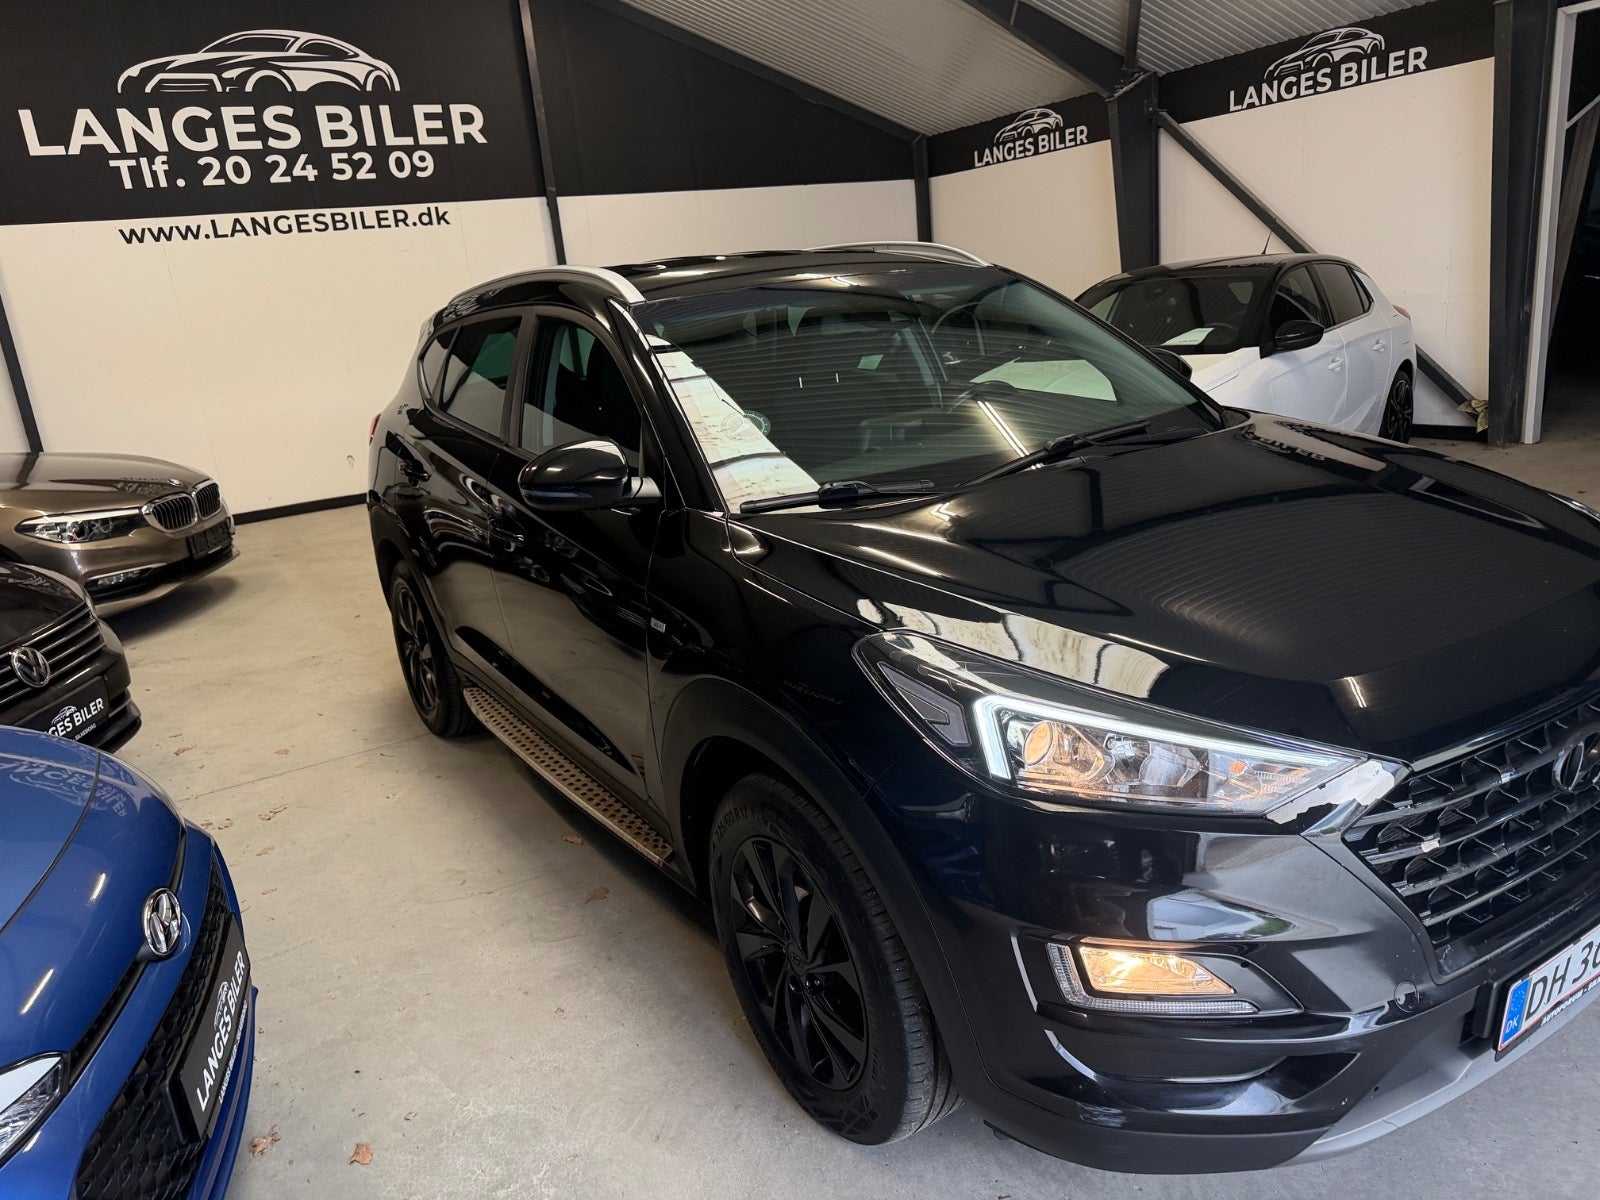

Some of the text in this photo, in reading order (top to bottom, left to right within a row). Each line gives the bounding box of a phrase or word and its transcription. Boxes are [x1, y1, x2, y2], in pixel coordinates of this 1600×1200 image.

[1229, 46, 1428, 112] LANGES BILER
[17, 104, 488, 156] LANGES BILER
[974, 125, 1088, 167] LANGES BILER
[108, 150, 435, 189] Tlf. 20 24 52 09
[118, 206, 451, 244] www.LANGESBILER.dk
[74, 698, 104, 727] BILER
[1525, 953, 1572, 1022] DH
[196, 950, 245, 1113] LANGES BILER
[1506, 1014, 1520, 1034] DK
